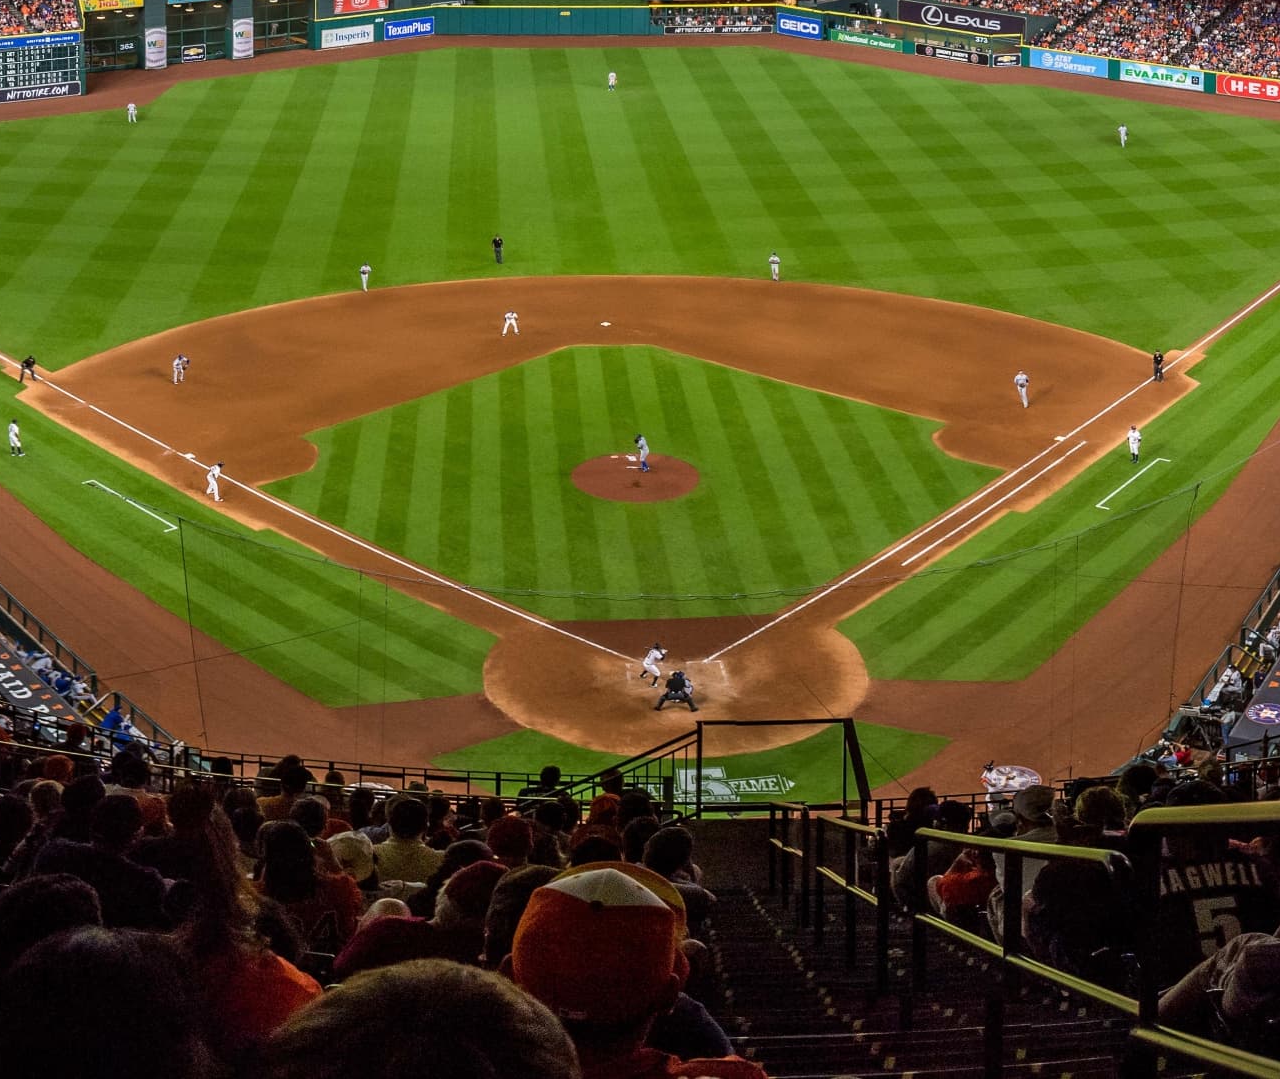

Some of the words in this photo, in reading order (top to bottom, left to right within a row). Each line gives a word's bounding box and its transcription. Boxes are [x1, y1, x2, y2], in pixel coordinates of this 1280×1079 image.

[387, 21, 432, 36] TexanPlus
[780, 20, 819, 35] GEICO
[944, 13, 1001, 31] LEXUS
[335, 29, 371, 42] Insperity
[844, 35, 869, 44] National
[878, 40, 896, 49] Rental
[119, 43, 134, 51] 362
[1125, 68, 1151, 79] EVA
[1151, 72, 1173, 82] AIR
[6, 85, 69, 101] NITTOTIRE.COM
[727, 778, 781, 793] FAME
[1192, 895, 1242, 957] 5
